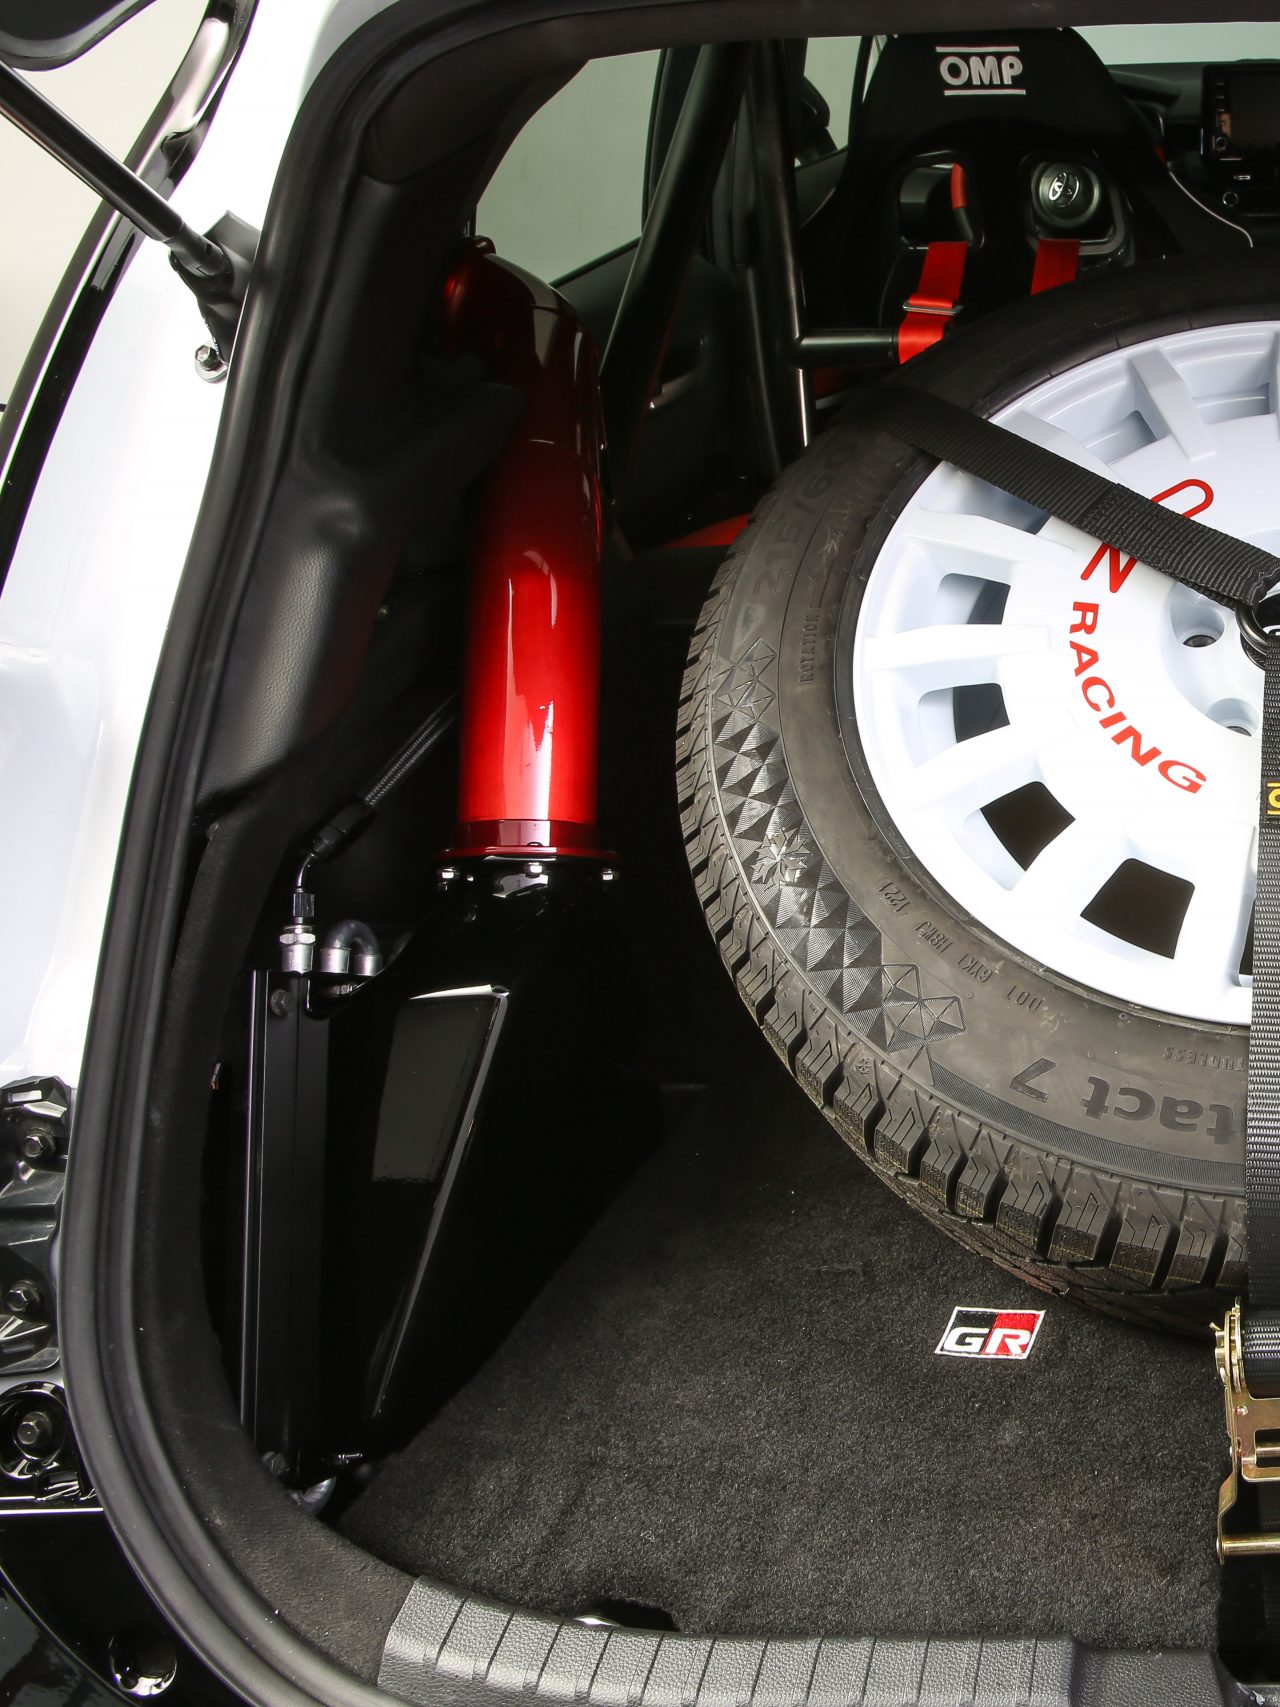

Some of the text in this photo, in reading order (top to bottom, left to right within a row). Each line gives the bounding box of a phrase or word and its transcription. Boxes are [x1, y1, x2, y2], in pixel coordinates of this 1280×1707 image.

[940, 56, 1023, 86] OMP
[1069, 601, 1207, 794] RACING
[1009, 1057, 1057, 1103] 7
[943, 1327, 1032, 1356] GR
